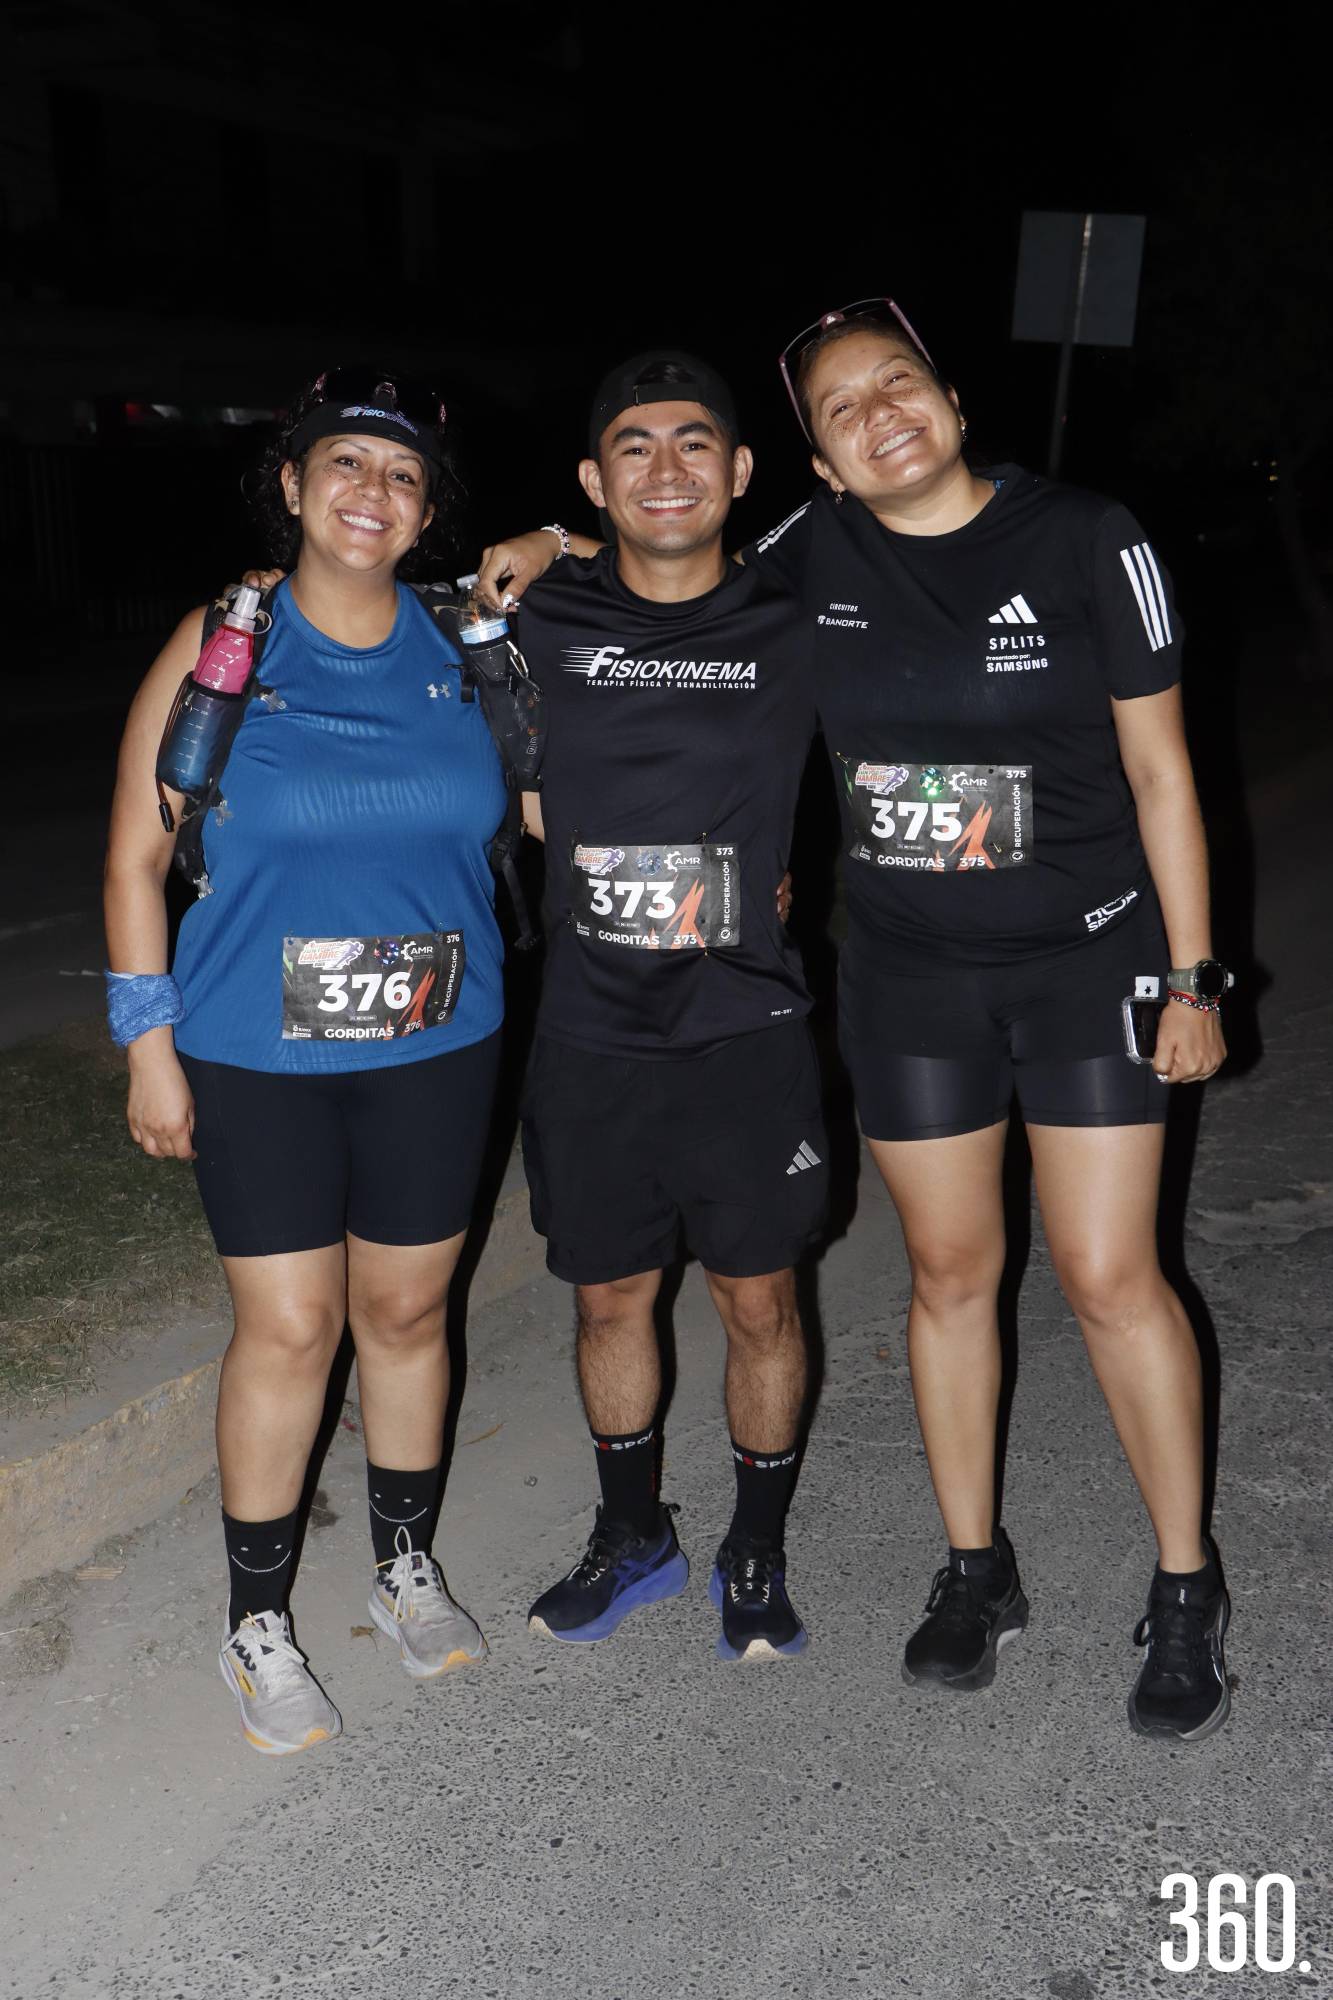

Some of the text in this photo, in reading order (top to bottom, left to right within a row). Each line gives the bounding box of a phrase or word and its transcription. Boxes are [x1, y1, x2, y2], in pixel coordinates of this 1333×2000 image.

[825, 617, 869, 629] BANORTE
[989, 634, 1046, 651] SPLITS
[587, 646, 757, 681] FISIOKINEMA
[1019, 653, 1031, 661] por:
[986, 657, 1049, 673] SAMSUNG
[586, 679, 625, 687] TERAPIA
[630, 679, 662, 688] FÍSICA
[676, 681, 757, 690] REHABILITACIÓN
[1005, 769, 1027, 779] 375
[960, 778, 988, 787] AMR
[870, 797, 963, 842] 375
[1014, 784, 1022, 848] RECUPERACIÓN
[716, 847, 734, 856] 373
[675, 857, 701, 865] AMR
[877, 855, 945, 868] GORDITAS
[959, 856, 986, 868] 375
[587, 877, 676, 919] 373
[722, 861, 731, 925] RECUPERACIÓN
[446, 933, 460, 944] 376
[598, 930, 660, 945] GORDITAS
[673, 934, 697, 945] 373
[410, 946, 434, 955] AMR
[317, 971, 412, 1013] 376
[324, 1026, 395, 1039] GORDITAS
[404, 1020, 422, 1034] 376
